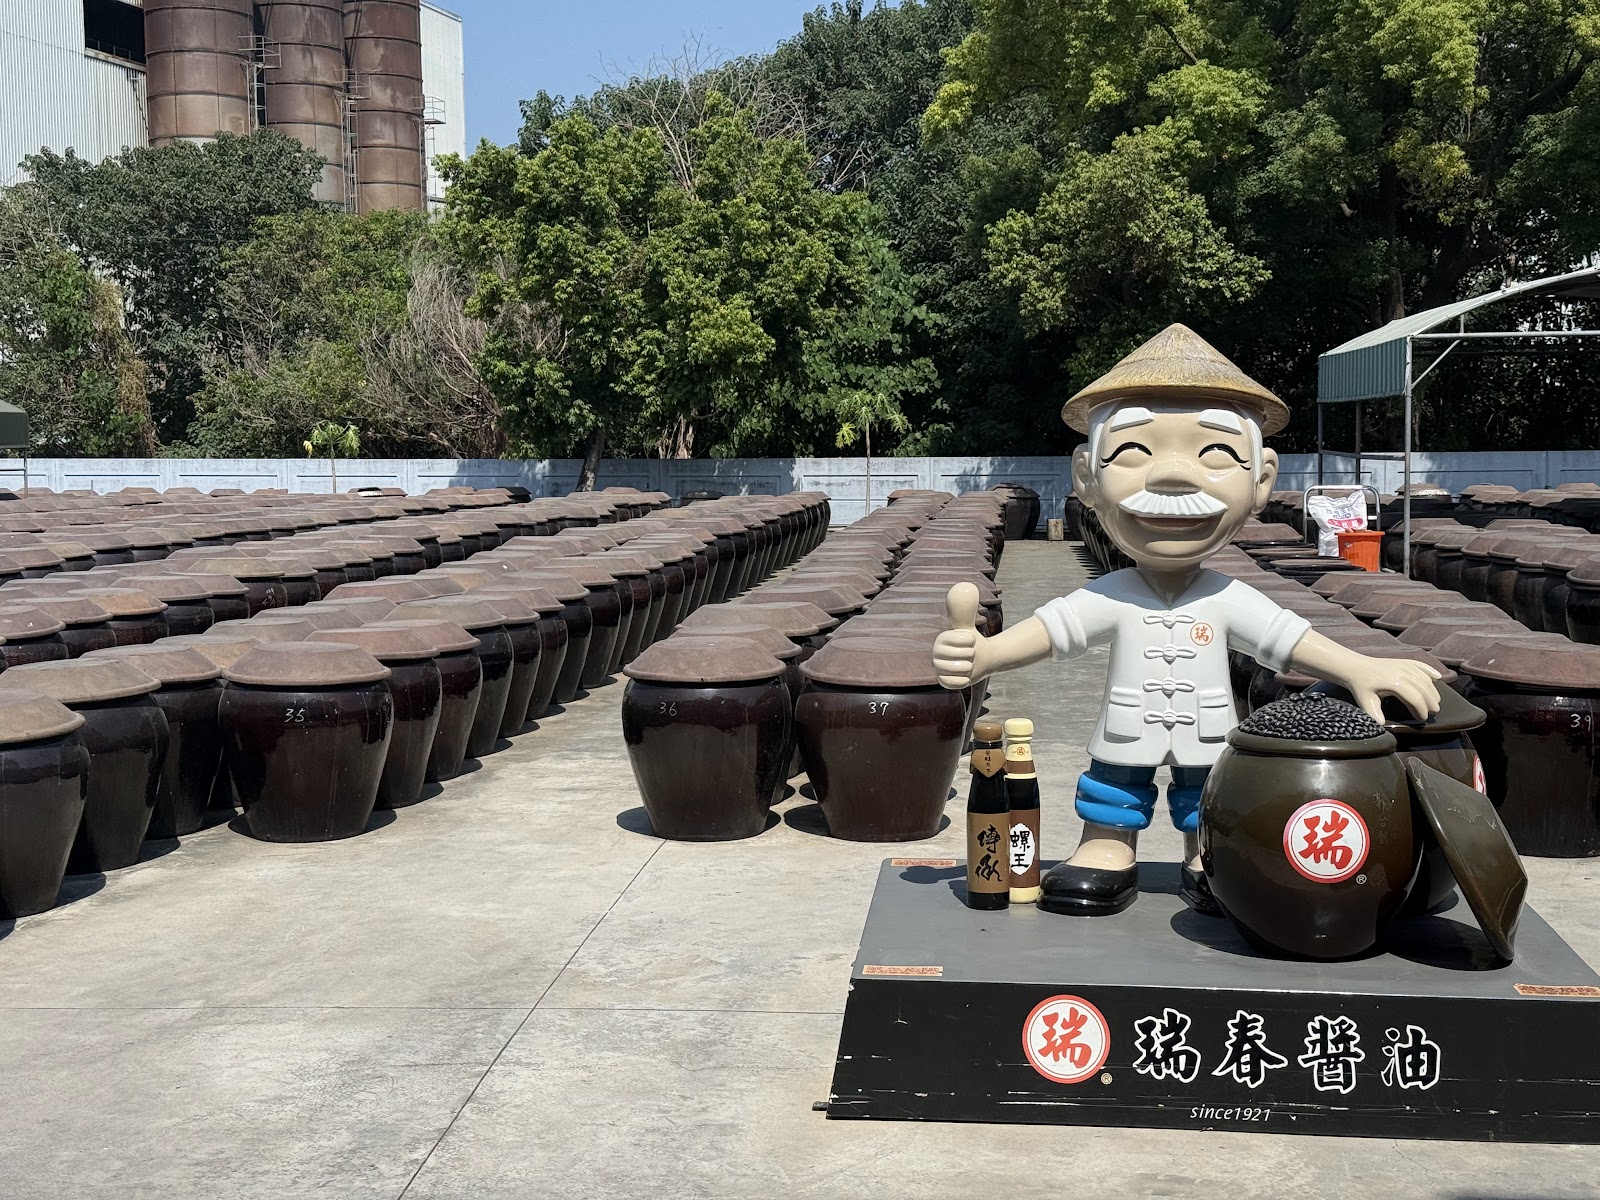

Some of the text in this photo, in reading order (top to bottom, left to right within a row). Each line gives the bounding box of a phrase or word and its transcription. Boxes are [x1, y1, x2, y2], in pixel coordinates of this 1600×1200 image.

[284, 707, 306, 723] 35
[659, 701, 678, 717] 36
[868, 701, 890, 716] 37
[1570, 713, 1592, 732] 39
[1009, 830, 1031, 868] 螺王
[1298, 810, 1354, 870] 瑞
[1037, 1006, 1093, 1069] 瑞
[1133, 1007, 1441, 1094] 瑞春醬油
[1189, 1103, 1271, 1121] since1921
